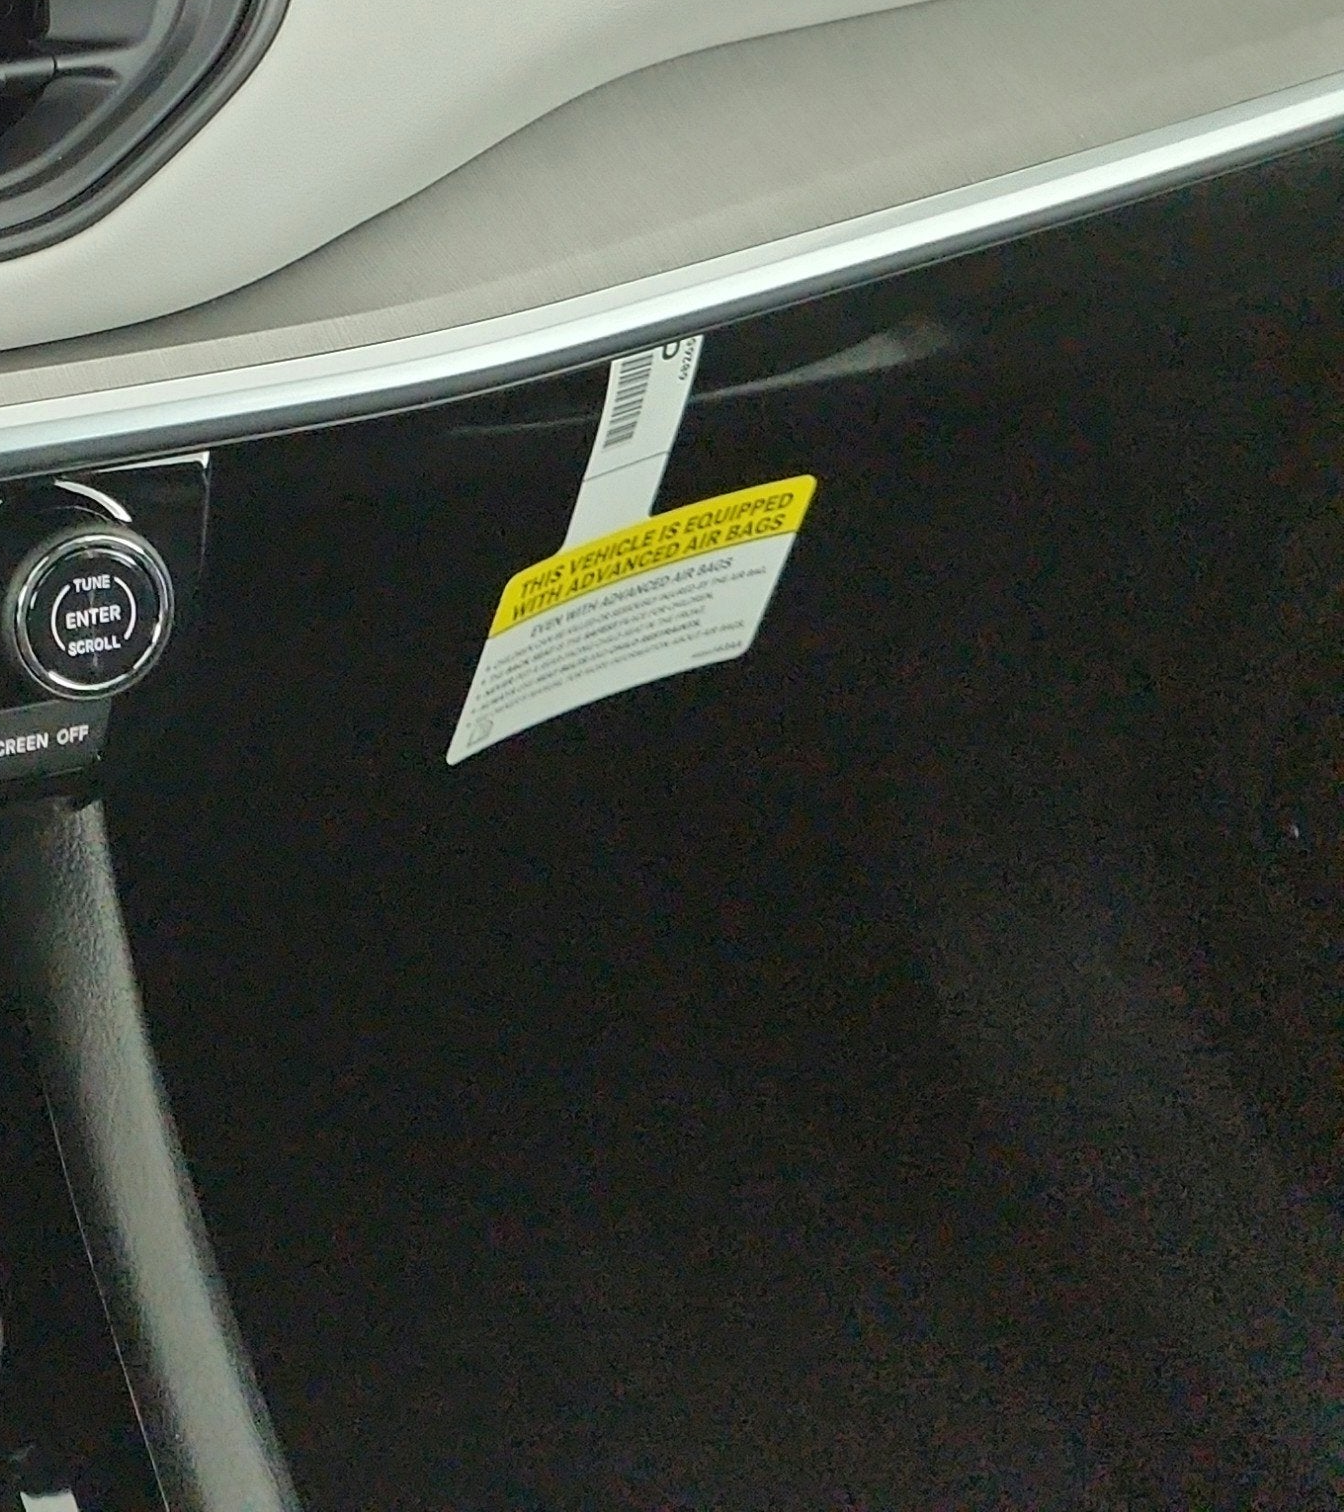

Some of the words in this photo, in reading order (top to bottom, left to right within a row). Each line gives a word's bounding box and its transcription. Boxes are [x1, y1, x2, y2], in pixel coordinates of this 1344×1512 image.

[520, 568, 564, 598] THIS
[569, 529, 655, 577] VEHICLE
[659, 522, 681, 541] IS
[684, 492, 794, 534] EQUIPPED
[512, 589, 562, 620] WITH
[566, 543, 680, 595] ADVANCED
[684, 530, 718, 552] AIR
[726, 513, 786, 539] BAGS
[73, 574, 111, 592] TUNE
[65, 605, 122, 630] ENTER
[67, 636, 122, 657] SCROLL
[56, 725, 90, 747] OFF
